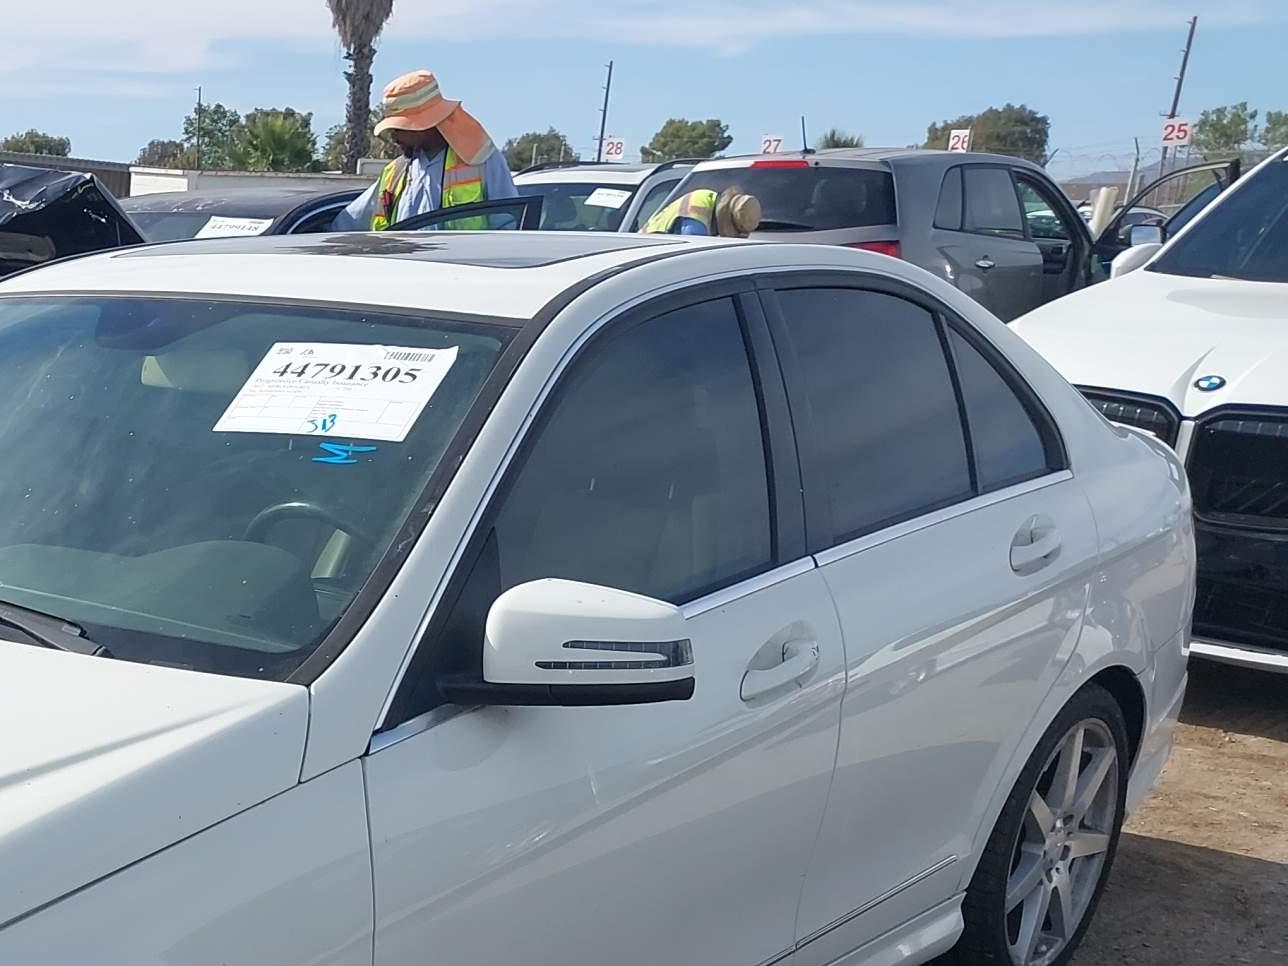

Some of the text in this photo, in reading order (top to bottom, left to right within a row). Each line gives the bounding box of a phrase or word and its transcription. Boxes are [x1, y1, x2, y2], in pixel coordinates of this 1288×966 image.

[1162, 123, 1189, 141] 25
[606, 141, 623, 155] 28
[763, 139, 782, 154] 27
[272, 361, 424, 384] 44791305
